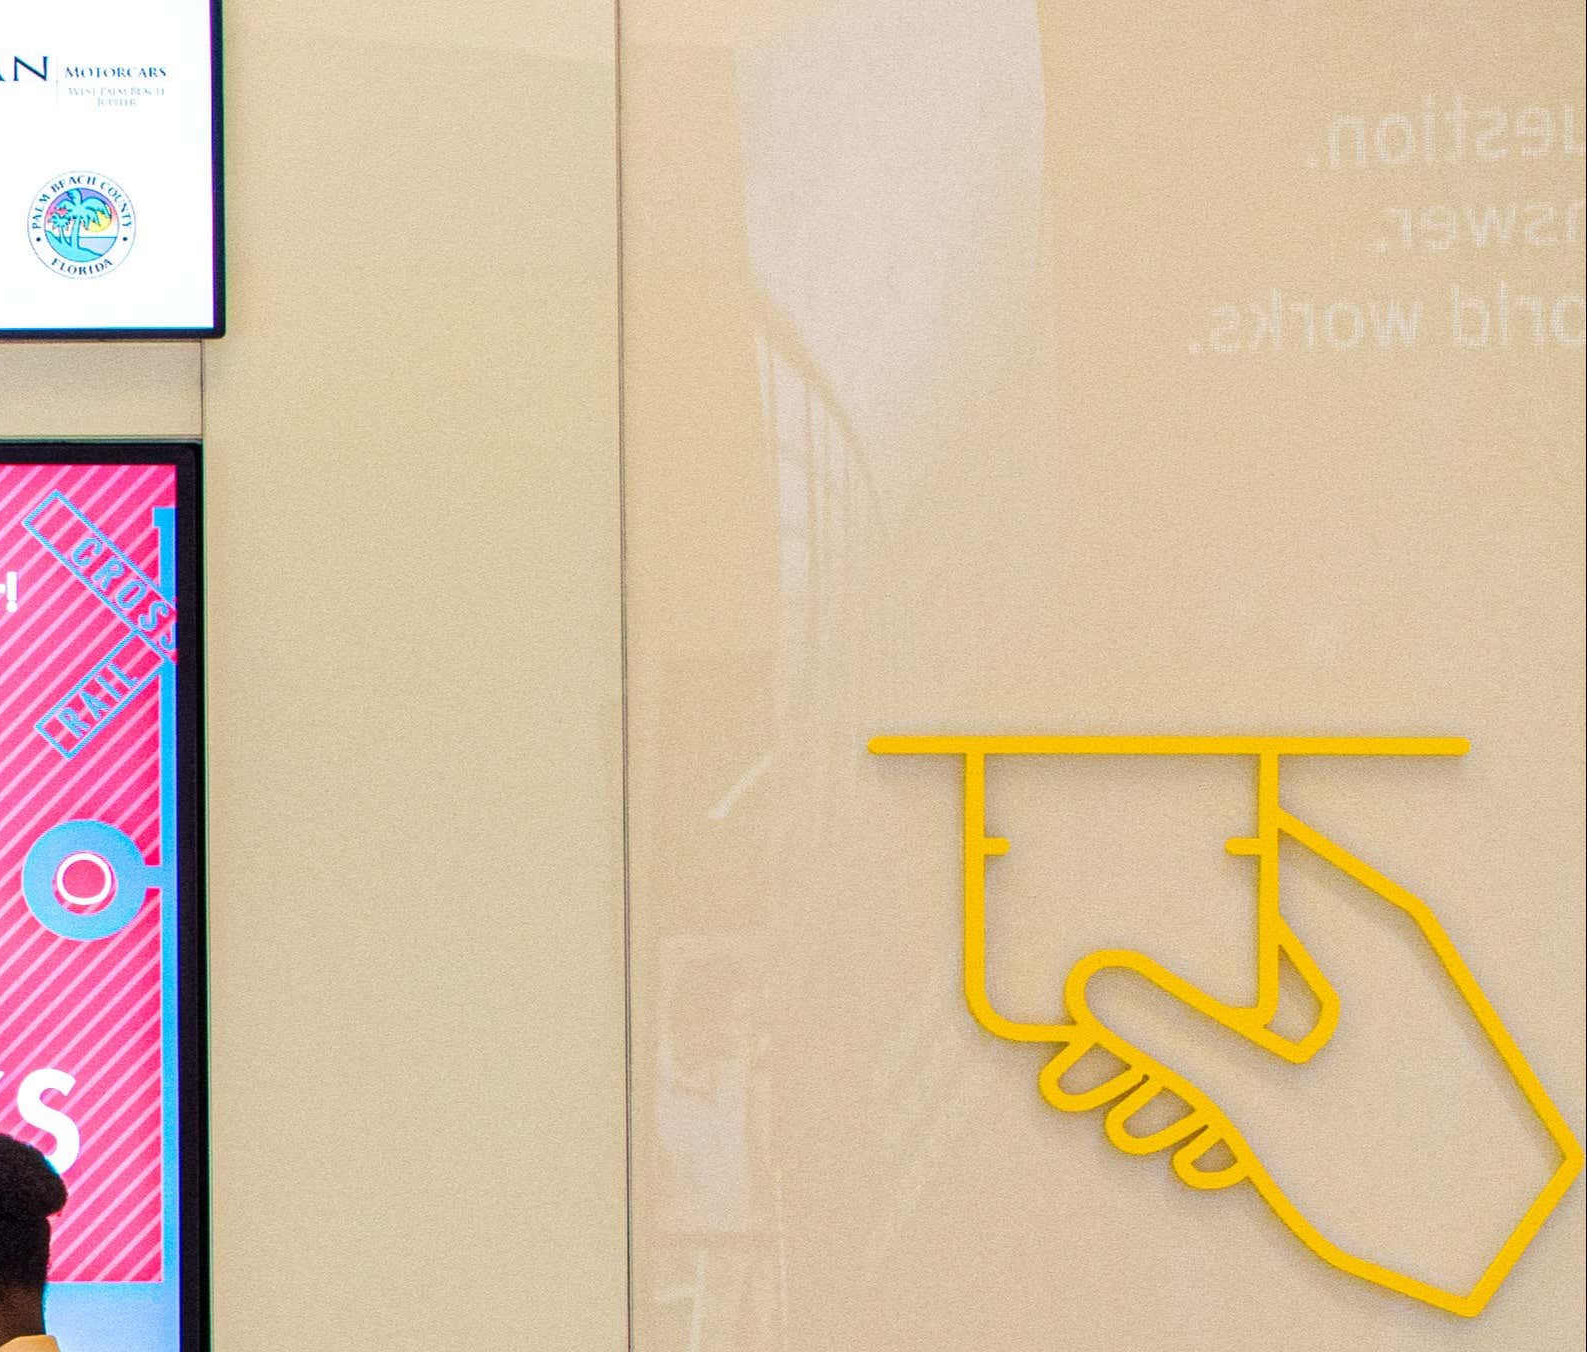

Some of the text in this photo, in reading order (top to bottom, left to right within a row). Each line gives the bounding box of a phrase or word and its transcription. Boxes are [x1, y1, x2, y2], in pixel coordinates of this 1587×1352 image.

[67, 67, 166, 78] MOTORCARS
[52, 258, 112, 275] FLORIDA
[54, 661, 139, 740] RAIL
